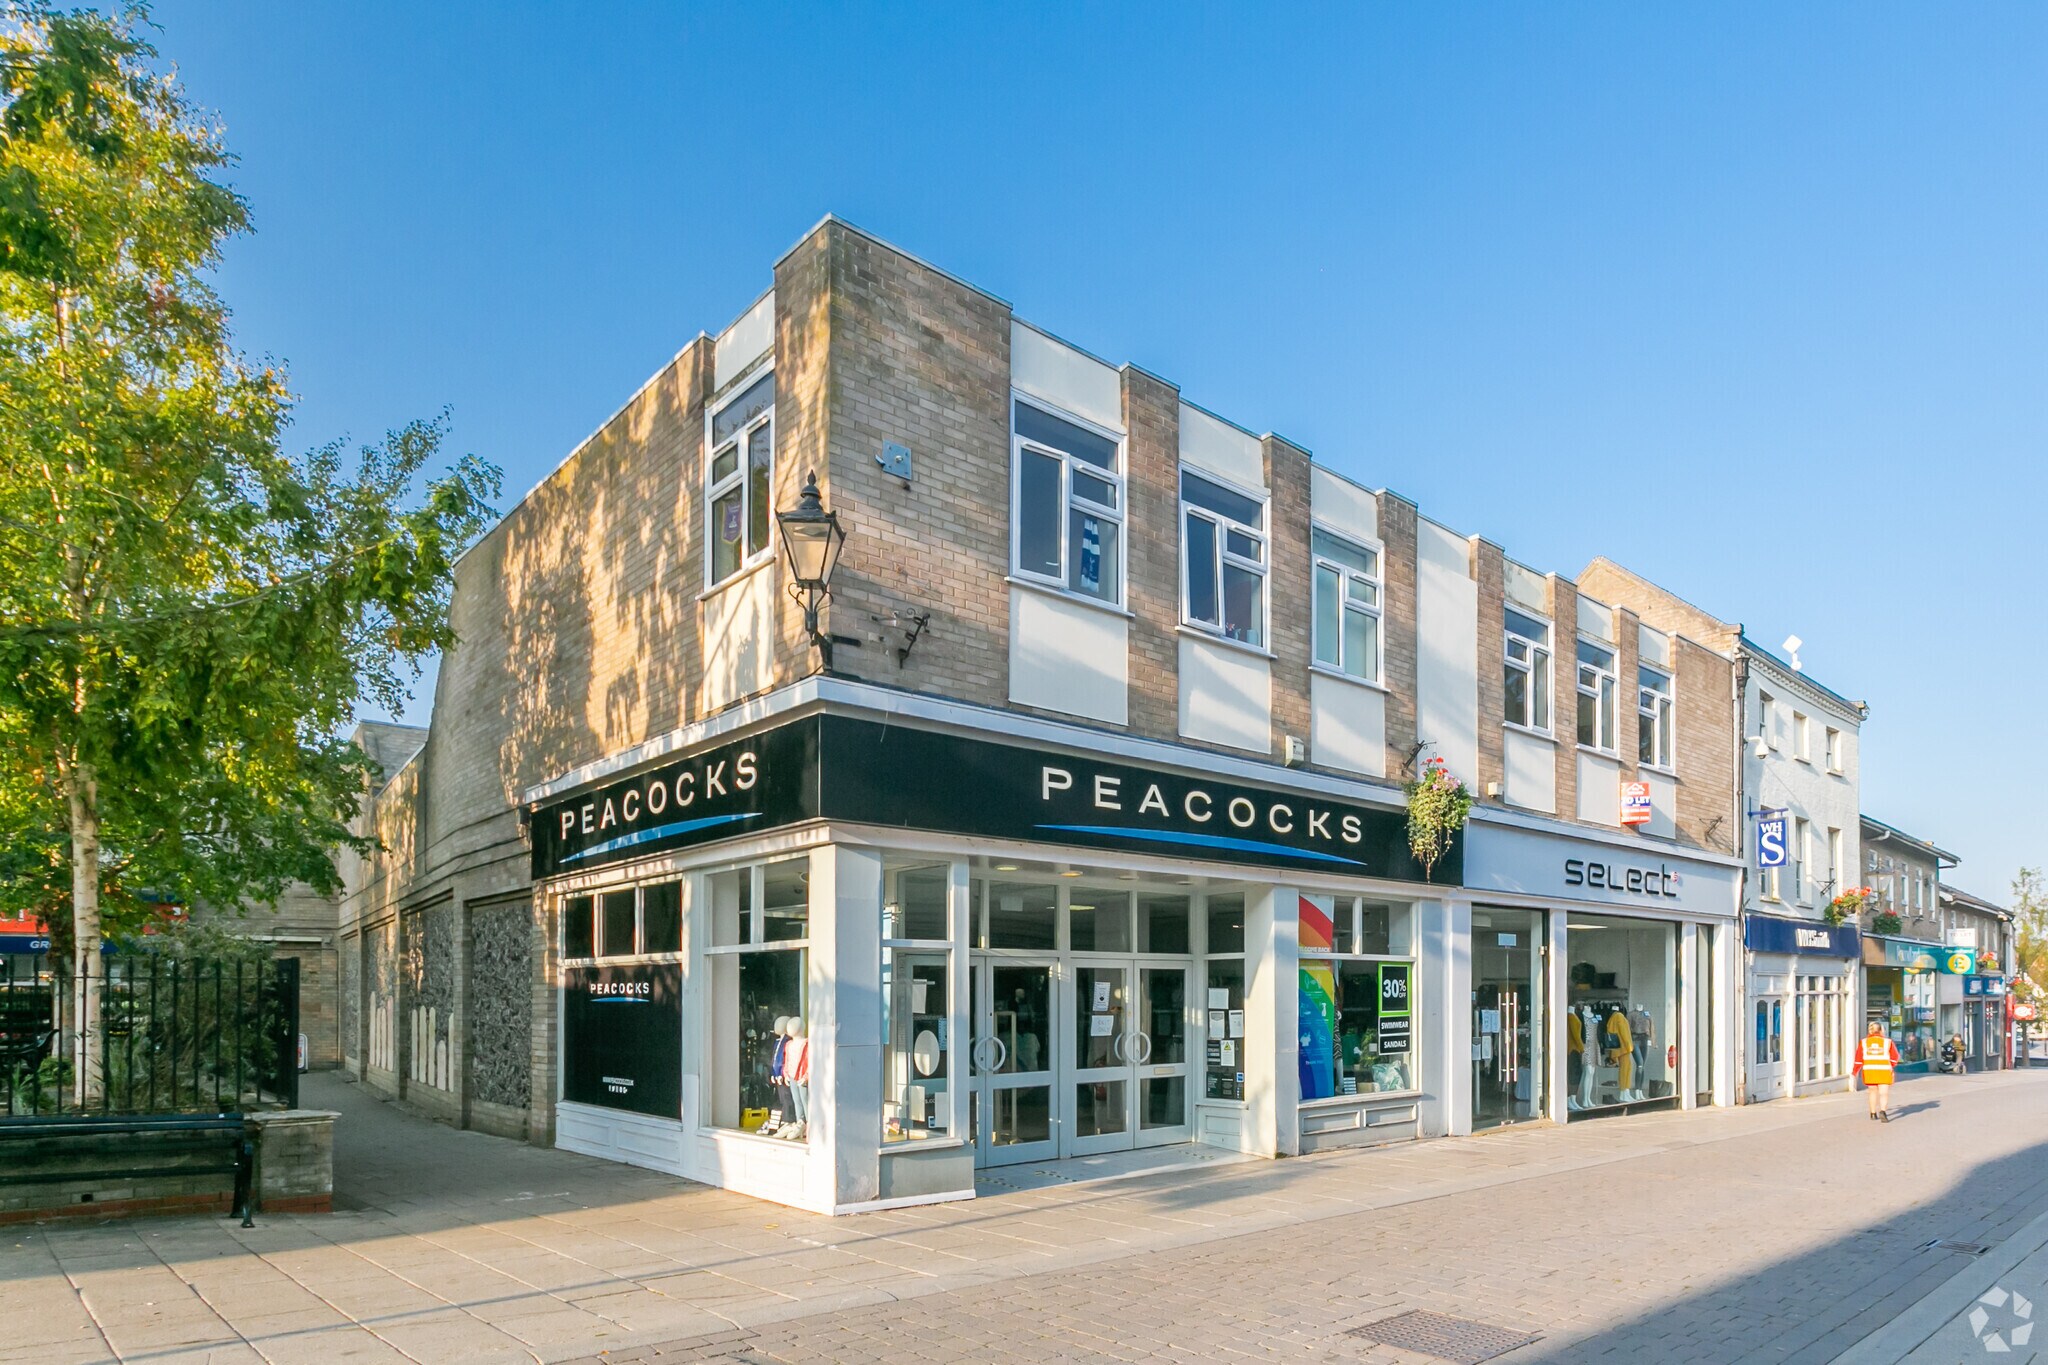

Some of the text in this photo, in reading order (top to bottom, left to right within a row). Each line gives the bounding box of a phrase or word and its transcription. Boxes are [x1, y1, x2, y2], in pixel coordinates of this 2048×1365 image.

[560, 752, 758, 840] PEACOCKS
[1041, 766, 1362, 843] PEACOCKS
[1760, 821, 1783, 833] WH
[1761, 831, 1785, 865] S
[590, 982, 650, 995] PEACOCKS
[1382, 979, 1407, 998] 30%
[1381, 1020, 1409, 1030] SWIMWEAR
[1384, 1039, 1407, 1049] SANDALS
